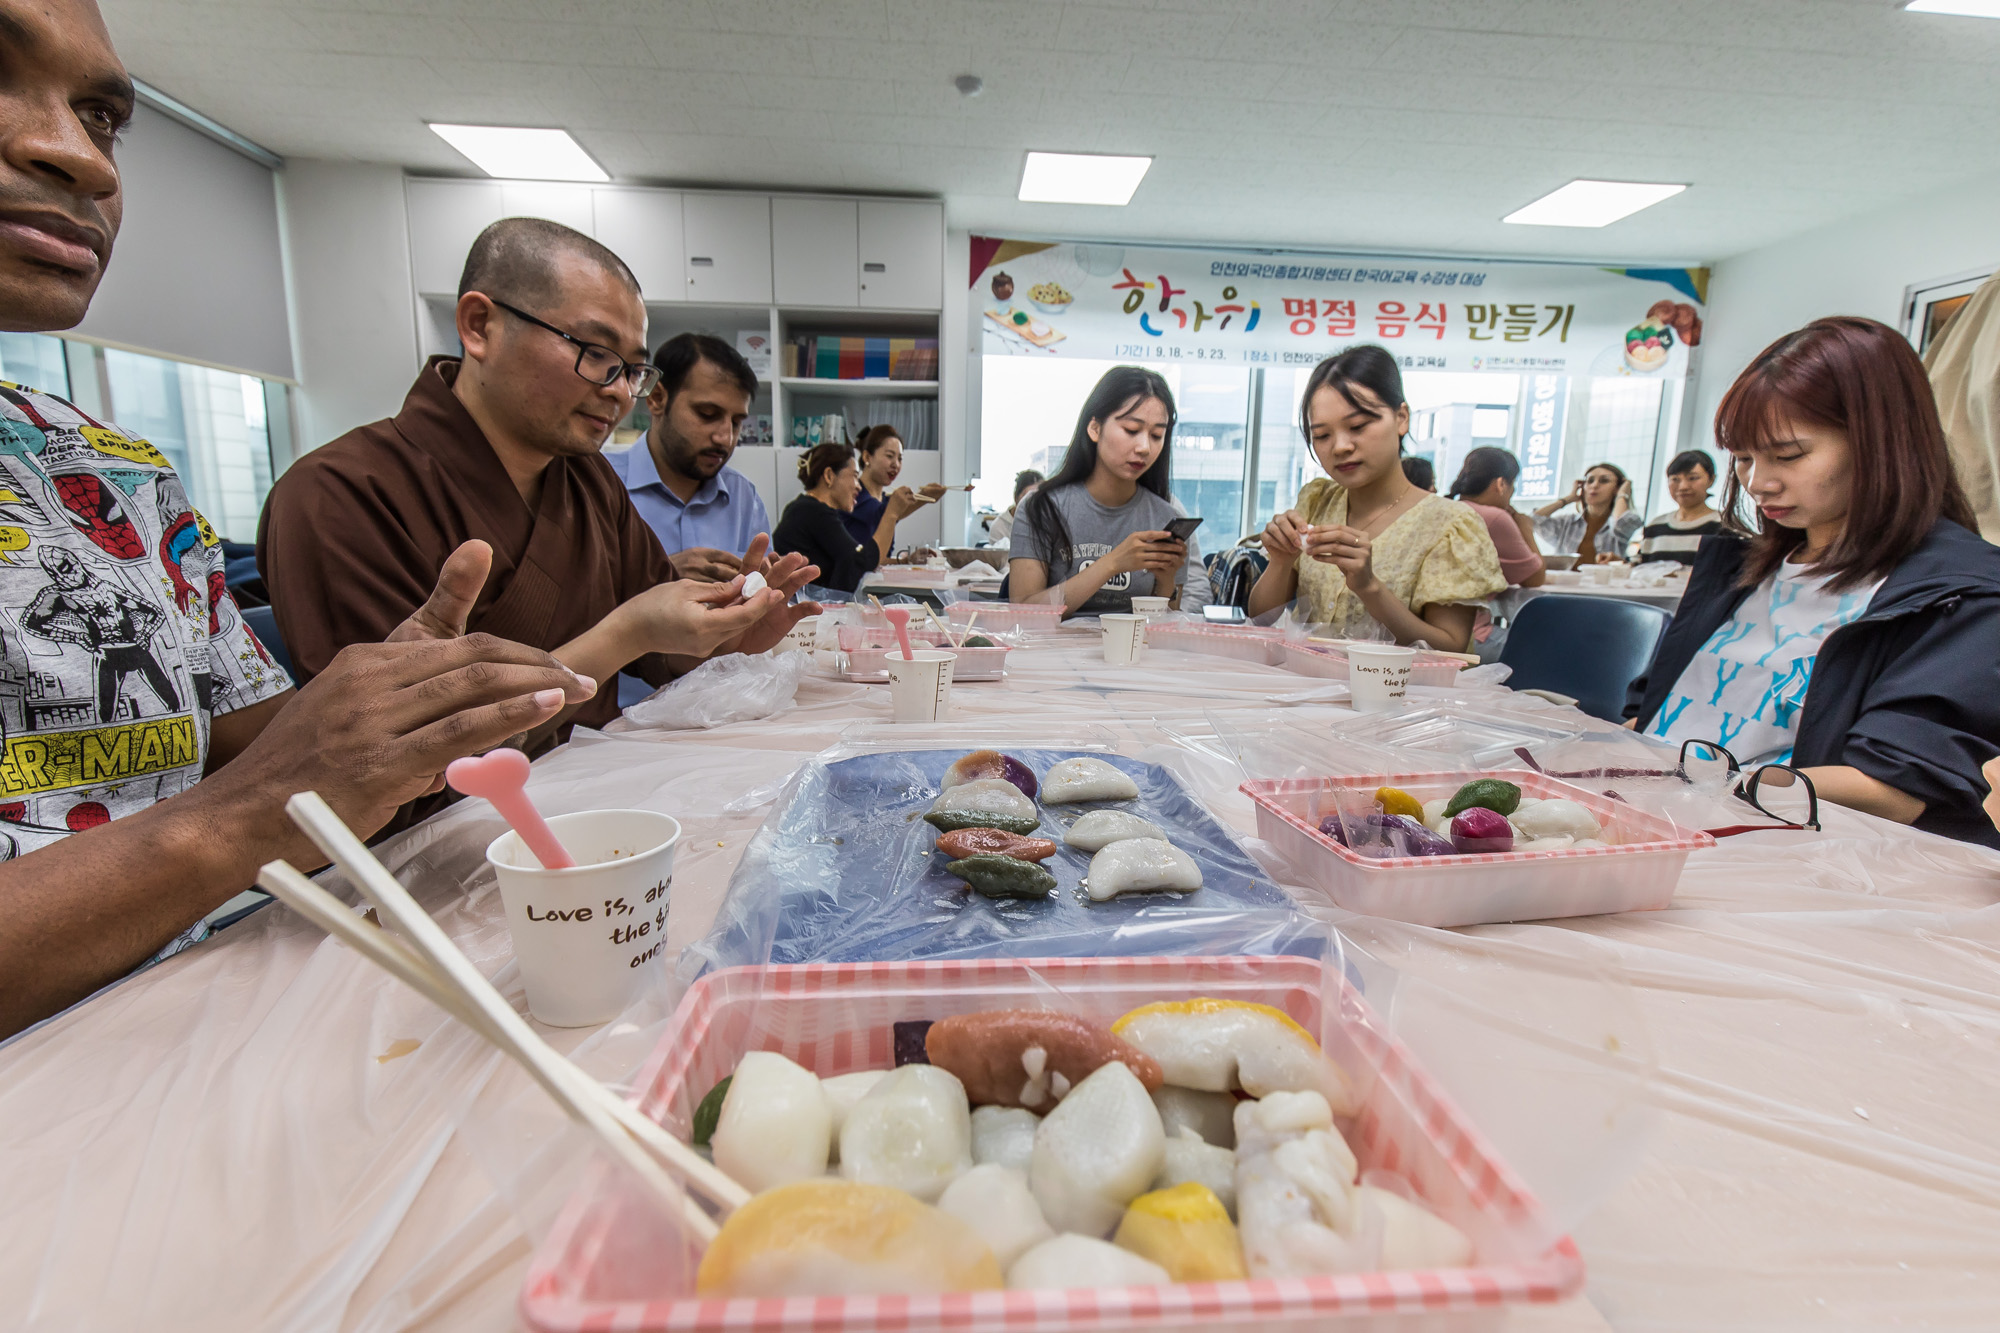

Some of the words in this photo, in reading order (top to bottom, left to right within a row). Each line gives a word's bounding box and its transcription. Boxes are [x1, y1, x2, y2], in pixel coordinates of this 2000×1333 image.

[1210, 260, 1352, 281] 인천외국인종합지원센터
[1354, 268, 1418, 284] 한국어교육
[1420, 271, 1459, 286] 수강생
[1460, 272, 1487, 287] 대상
[1112, 268, 1261, 337] 한가위
[1281, 297, 1356, 337] 명절
[1375, 301, 1447, 340] 음식
[1464, 304, 1575, 343] 만들기
[41, 450, 95, 466] TARTING
[1357, 664, 1379, 674] Love
[1382, 667, 1394, 676] is,
[526, 904, 593, 922] Love
[604, 897, 635, 918] is,
[608, 921, 651, 945] the
